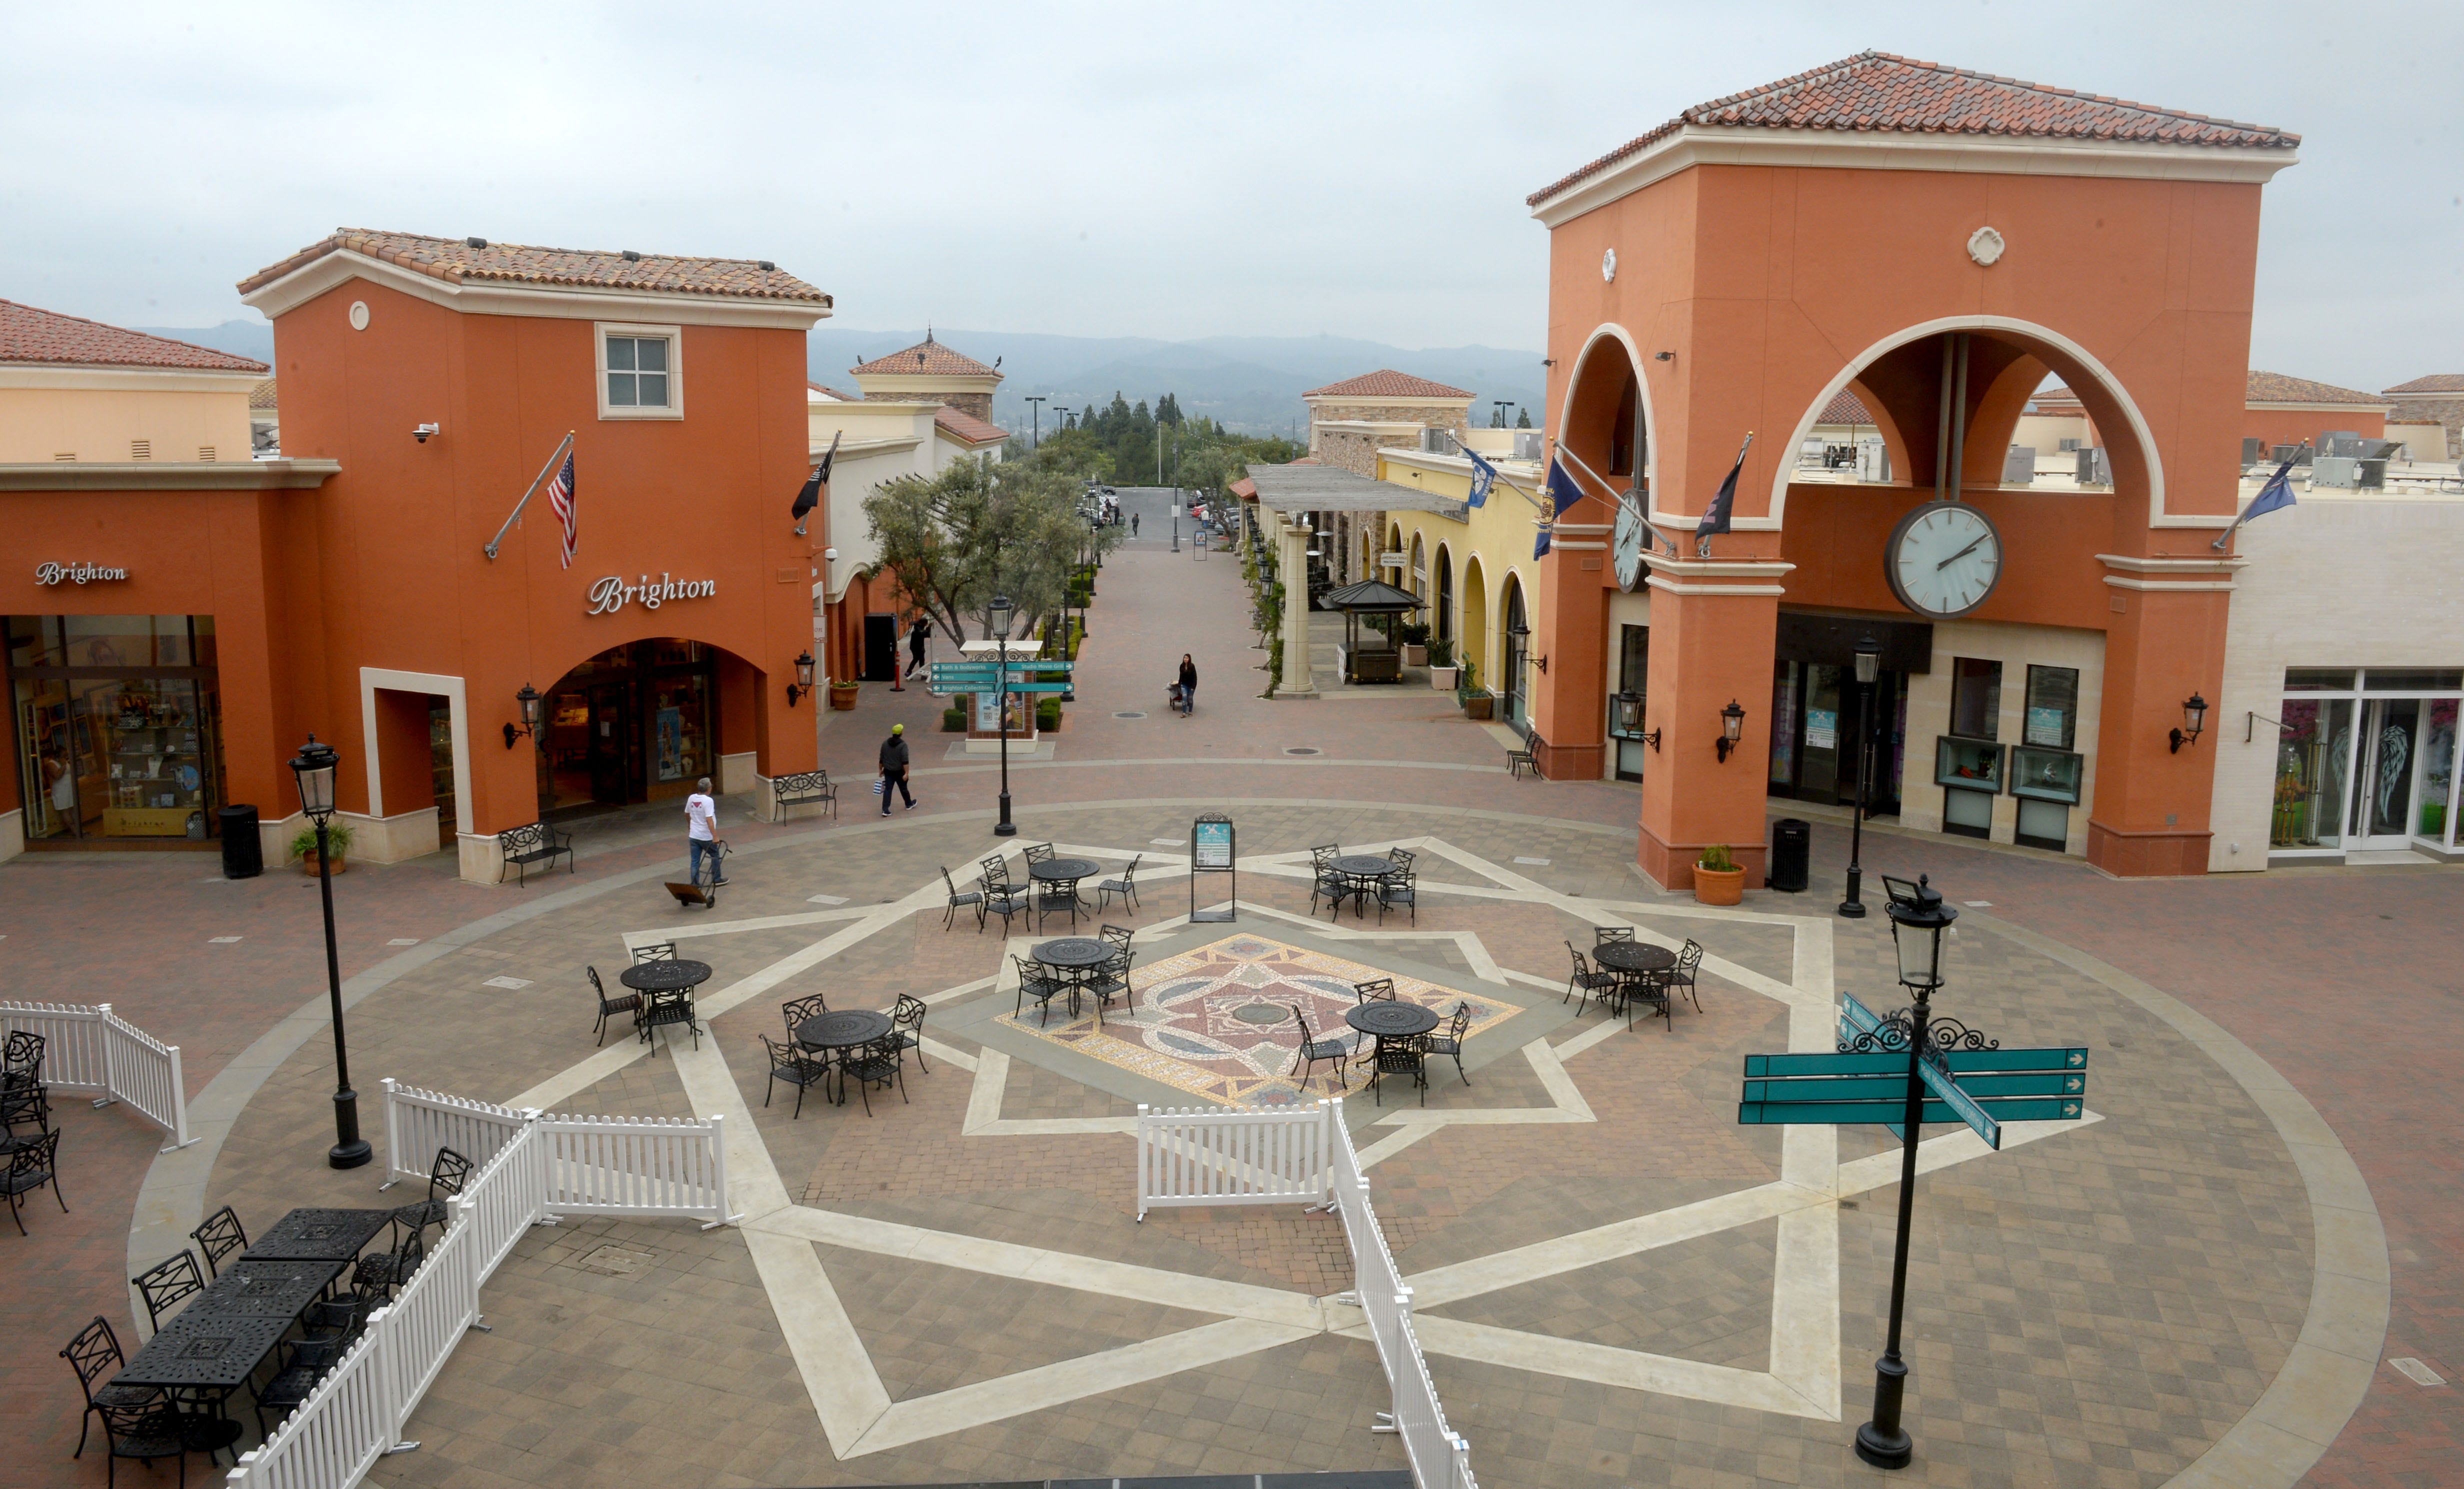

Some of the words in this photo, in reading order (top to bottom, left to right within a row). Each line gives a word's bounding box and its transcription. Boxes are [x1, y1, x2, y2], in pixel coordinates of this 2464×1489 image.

[35, 562, 126, 584] Brighton
[588, 572, 716, 614] Brighton
[1920, 1064, 1931, 1080] Mall
[1932, 1074, 1966, 1114] Management
[1966, 1108, 1983, 1130] Office
